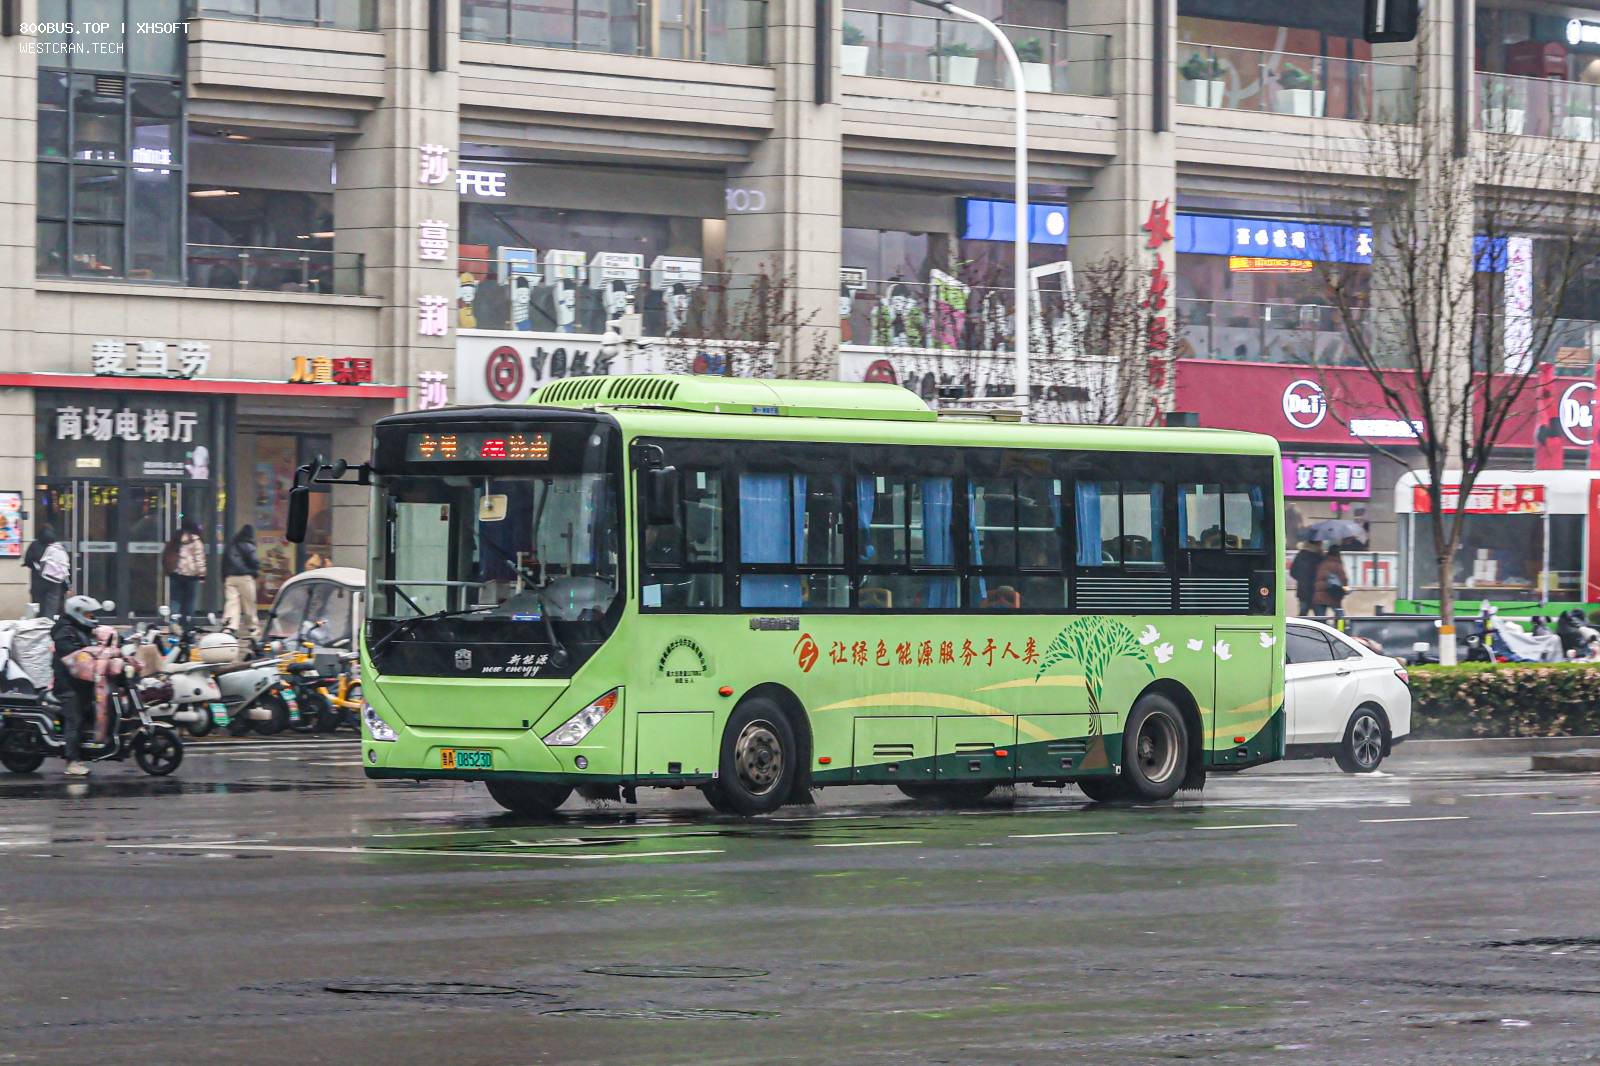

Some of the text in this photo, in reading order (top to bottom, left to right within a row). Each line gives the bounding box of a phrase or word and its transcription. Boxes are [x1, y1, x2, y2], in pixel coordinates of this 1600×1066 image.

[91, 338, 211, 380] 麦当劳
[56, 405, 198, 443] 商场电梯厅
[507, 653, 549, 666] 新能源
[828, 636, 1040, 668] 让绿色能源服务于人类
[481, 665, 540, 678] new energy
